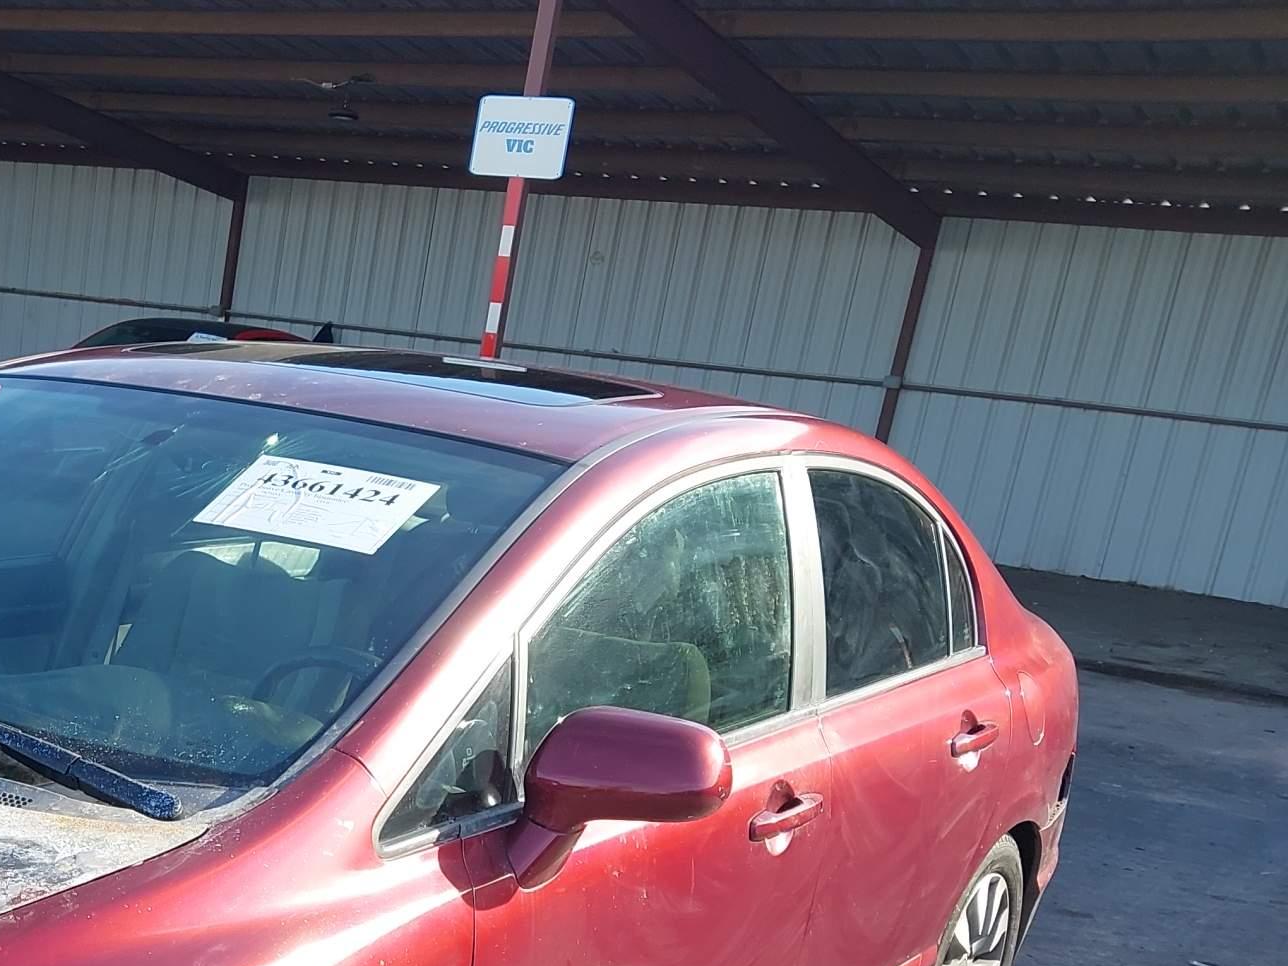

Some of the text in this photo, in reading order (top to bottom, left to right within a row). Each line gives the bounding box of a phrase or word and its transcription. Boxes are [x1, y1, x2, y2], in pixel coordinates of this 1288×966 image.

[479, 120, 566, 136] PROGRESSIVE
[505, 138, 535, 154] VIC
[257, 471, 401, 507] 43661424
